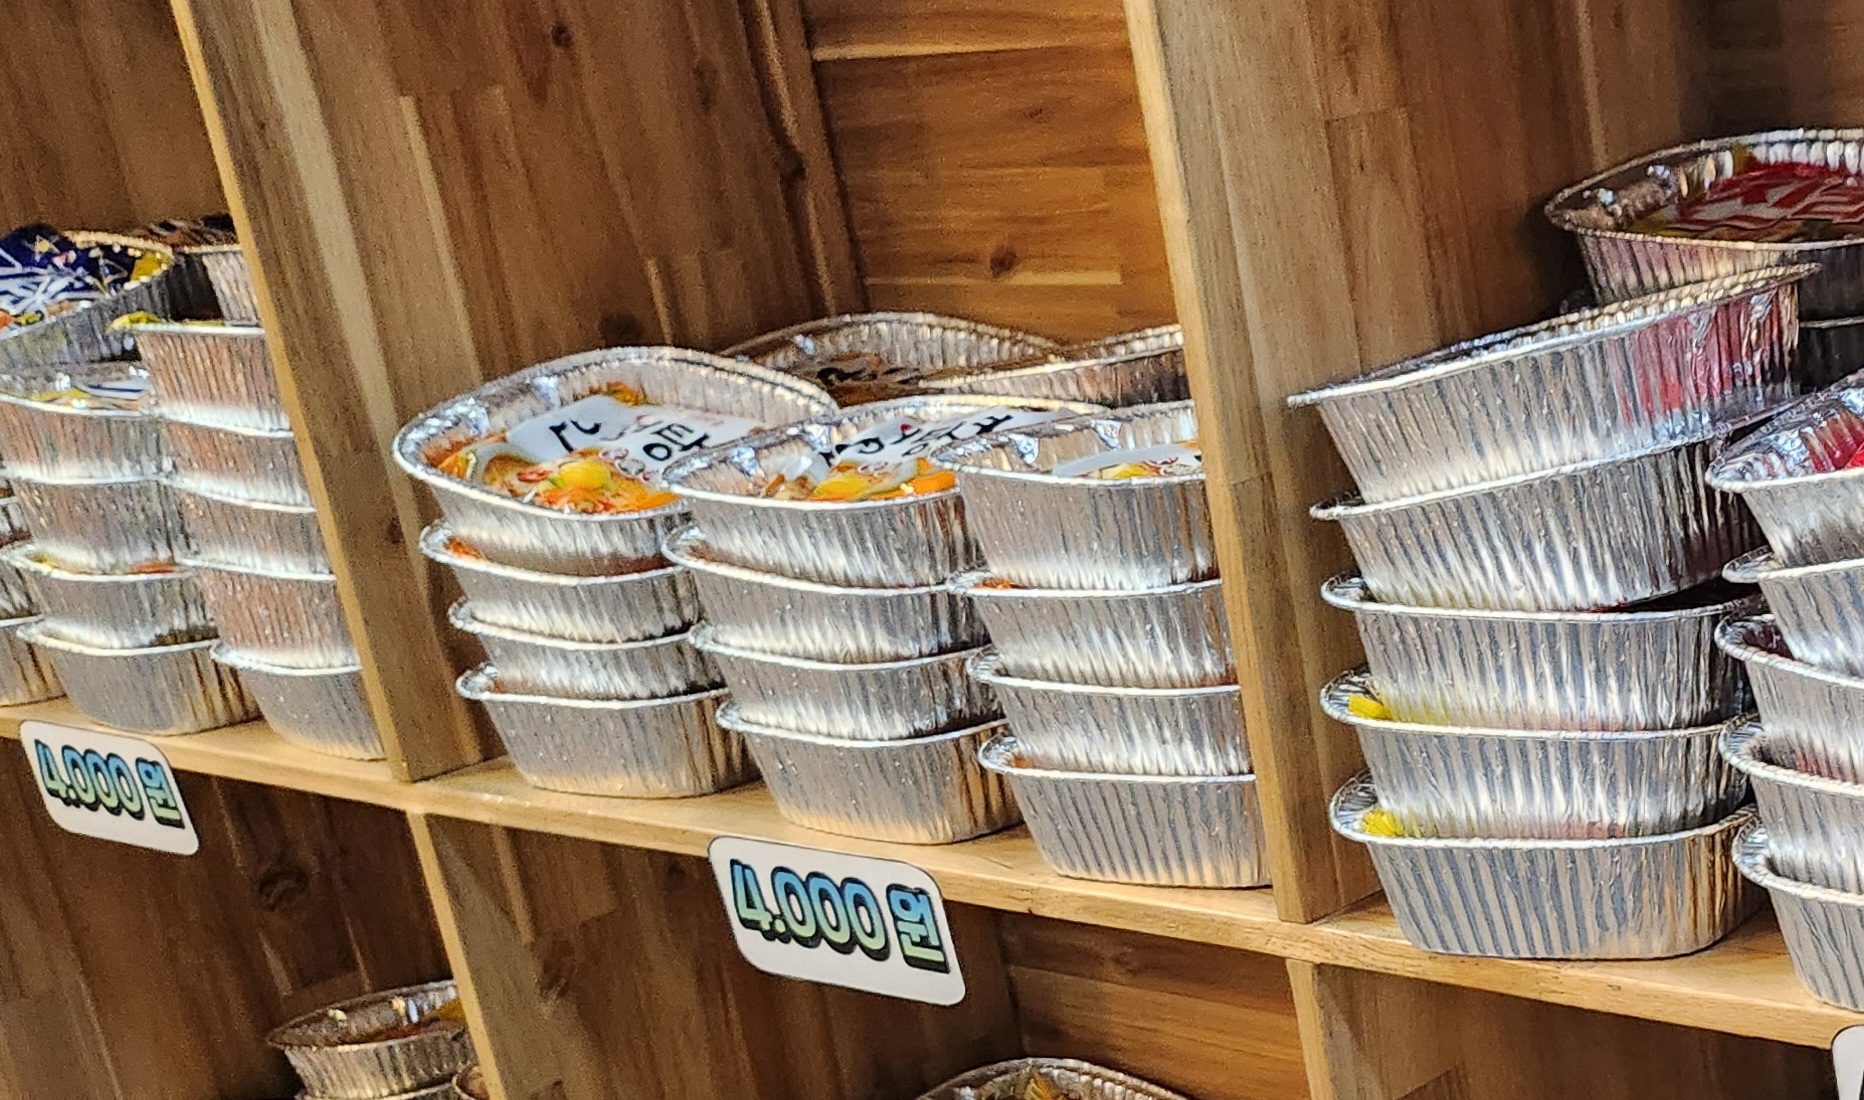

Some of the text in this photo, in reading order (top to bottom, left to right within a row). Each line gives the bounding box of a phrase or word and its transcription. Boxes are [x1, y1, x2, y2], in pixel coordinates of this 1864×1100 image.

[34, 738, 186, 830] 4.000 원
[729, 858, 951, 975] 4.000 원
